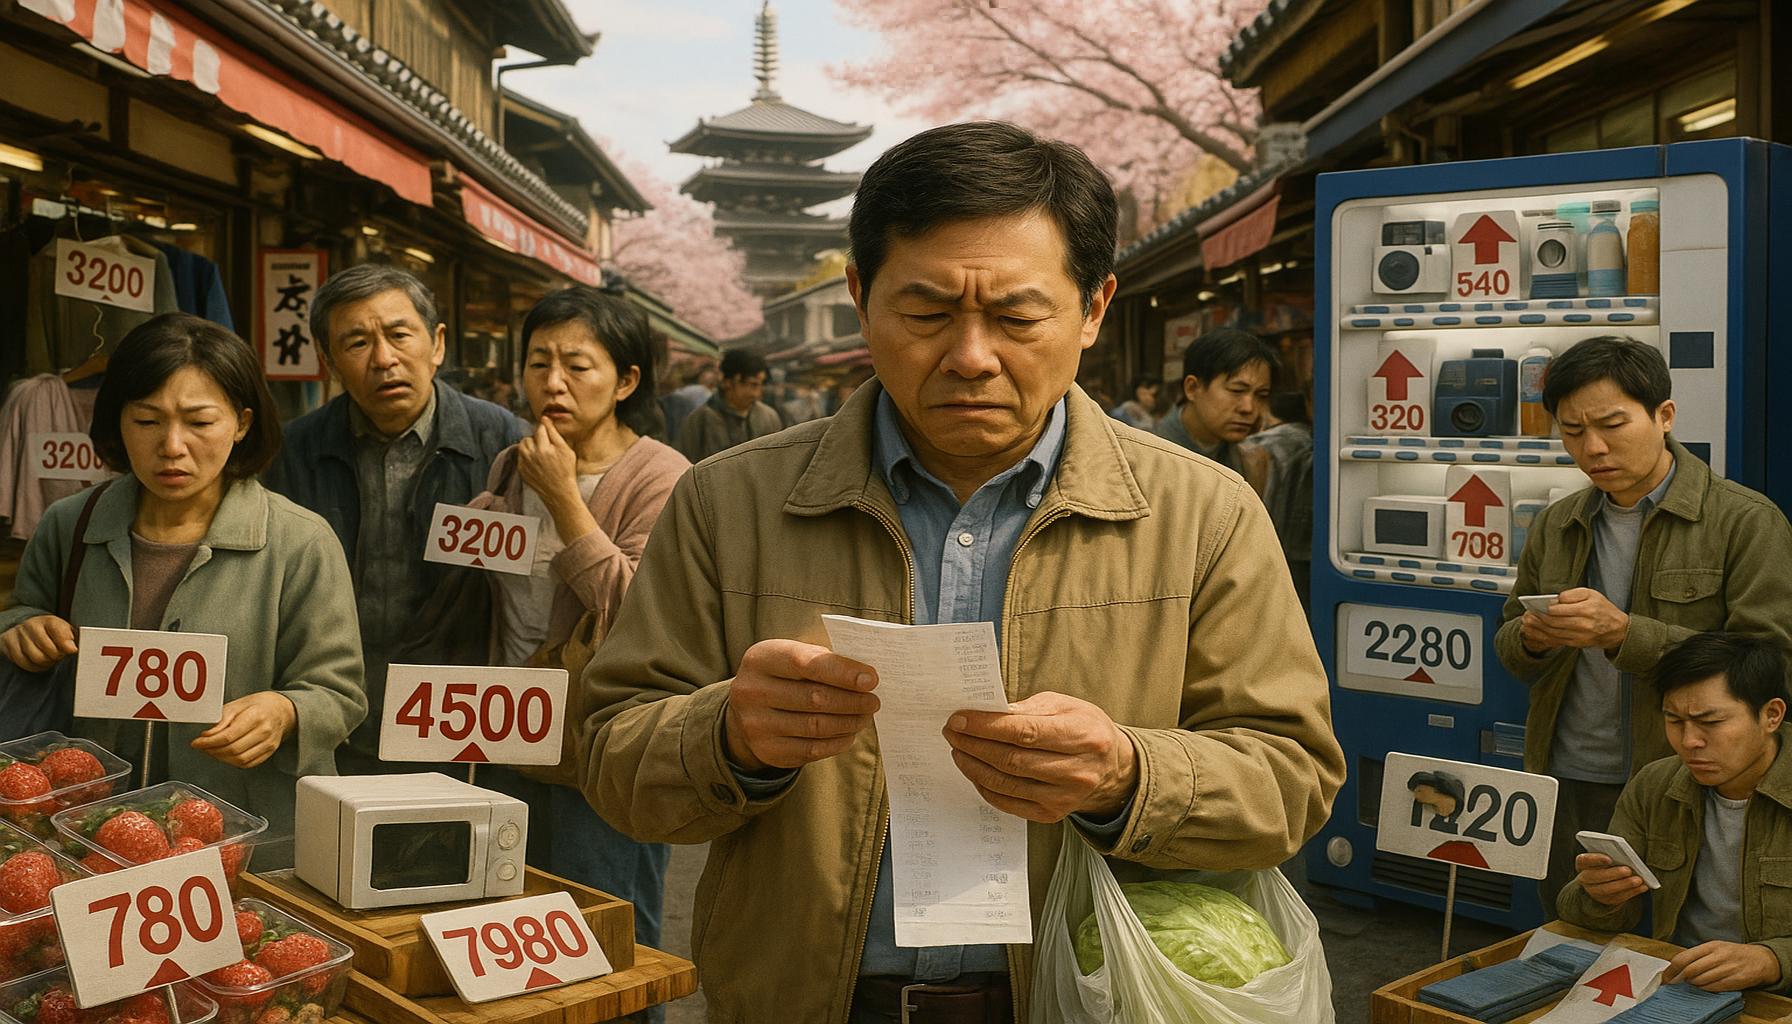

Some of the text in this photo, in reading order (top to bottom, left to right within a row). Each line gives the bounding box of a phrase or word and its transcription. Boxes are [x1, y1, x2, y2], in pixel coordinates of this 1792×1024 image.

[66, 250, 144, 298] 3200
[1457, 269, 1510, 298] 540
[1371, 404, 1424, 431] 320
[438, 514, 526, 561] 3200
[1451, 531, 1504, 560] 708
[1364, 620, 1471, 671] 2280
[101, 645, 207, 703] 780
[395, 681, 553, 743] 4500
[88, 875, 224, 969] 780
[442, 910, 590, 977] 7980
